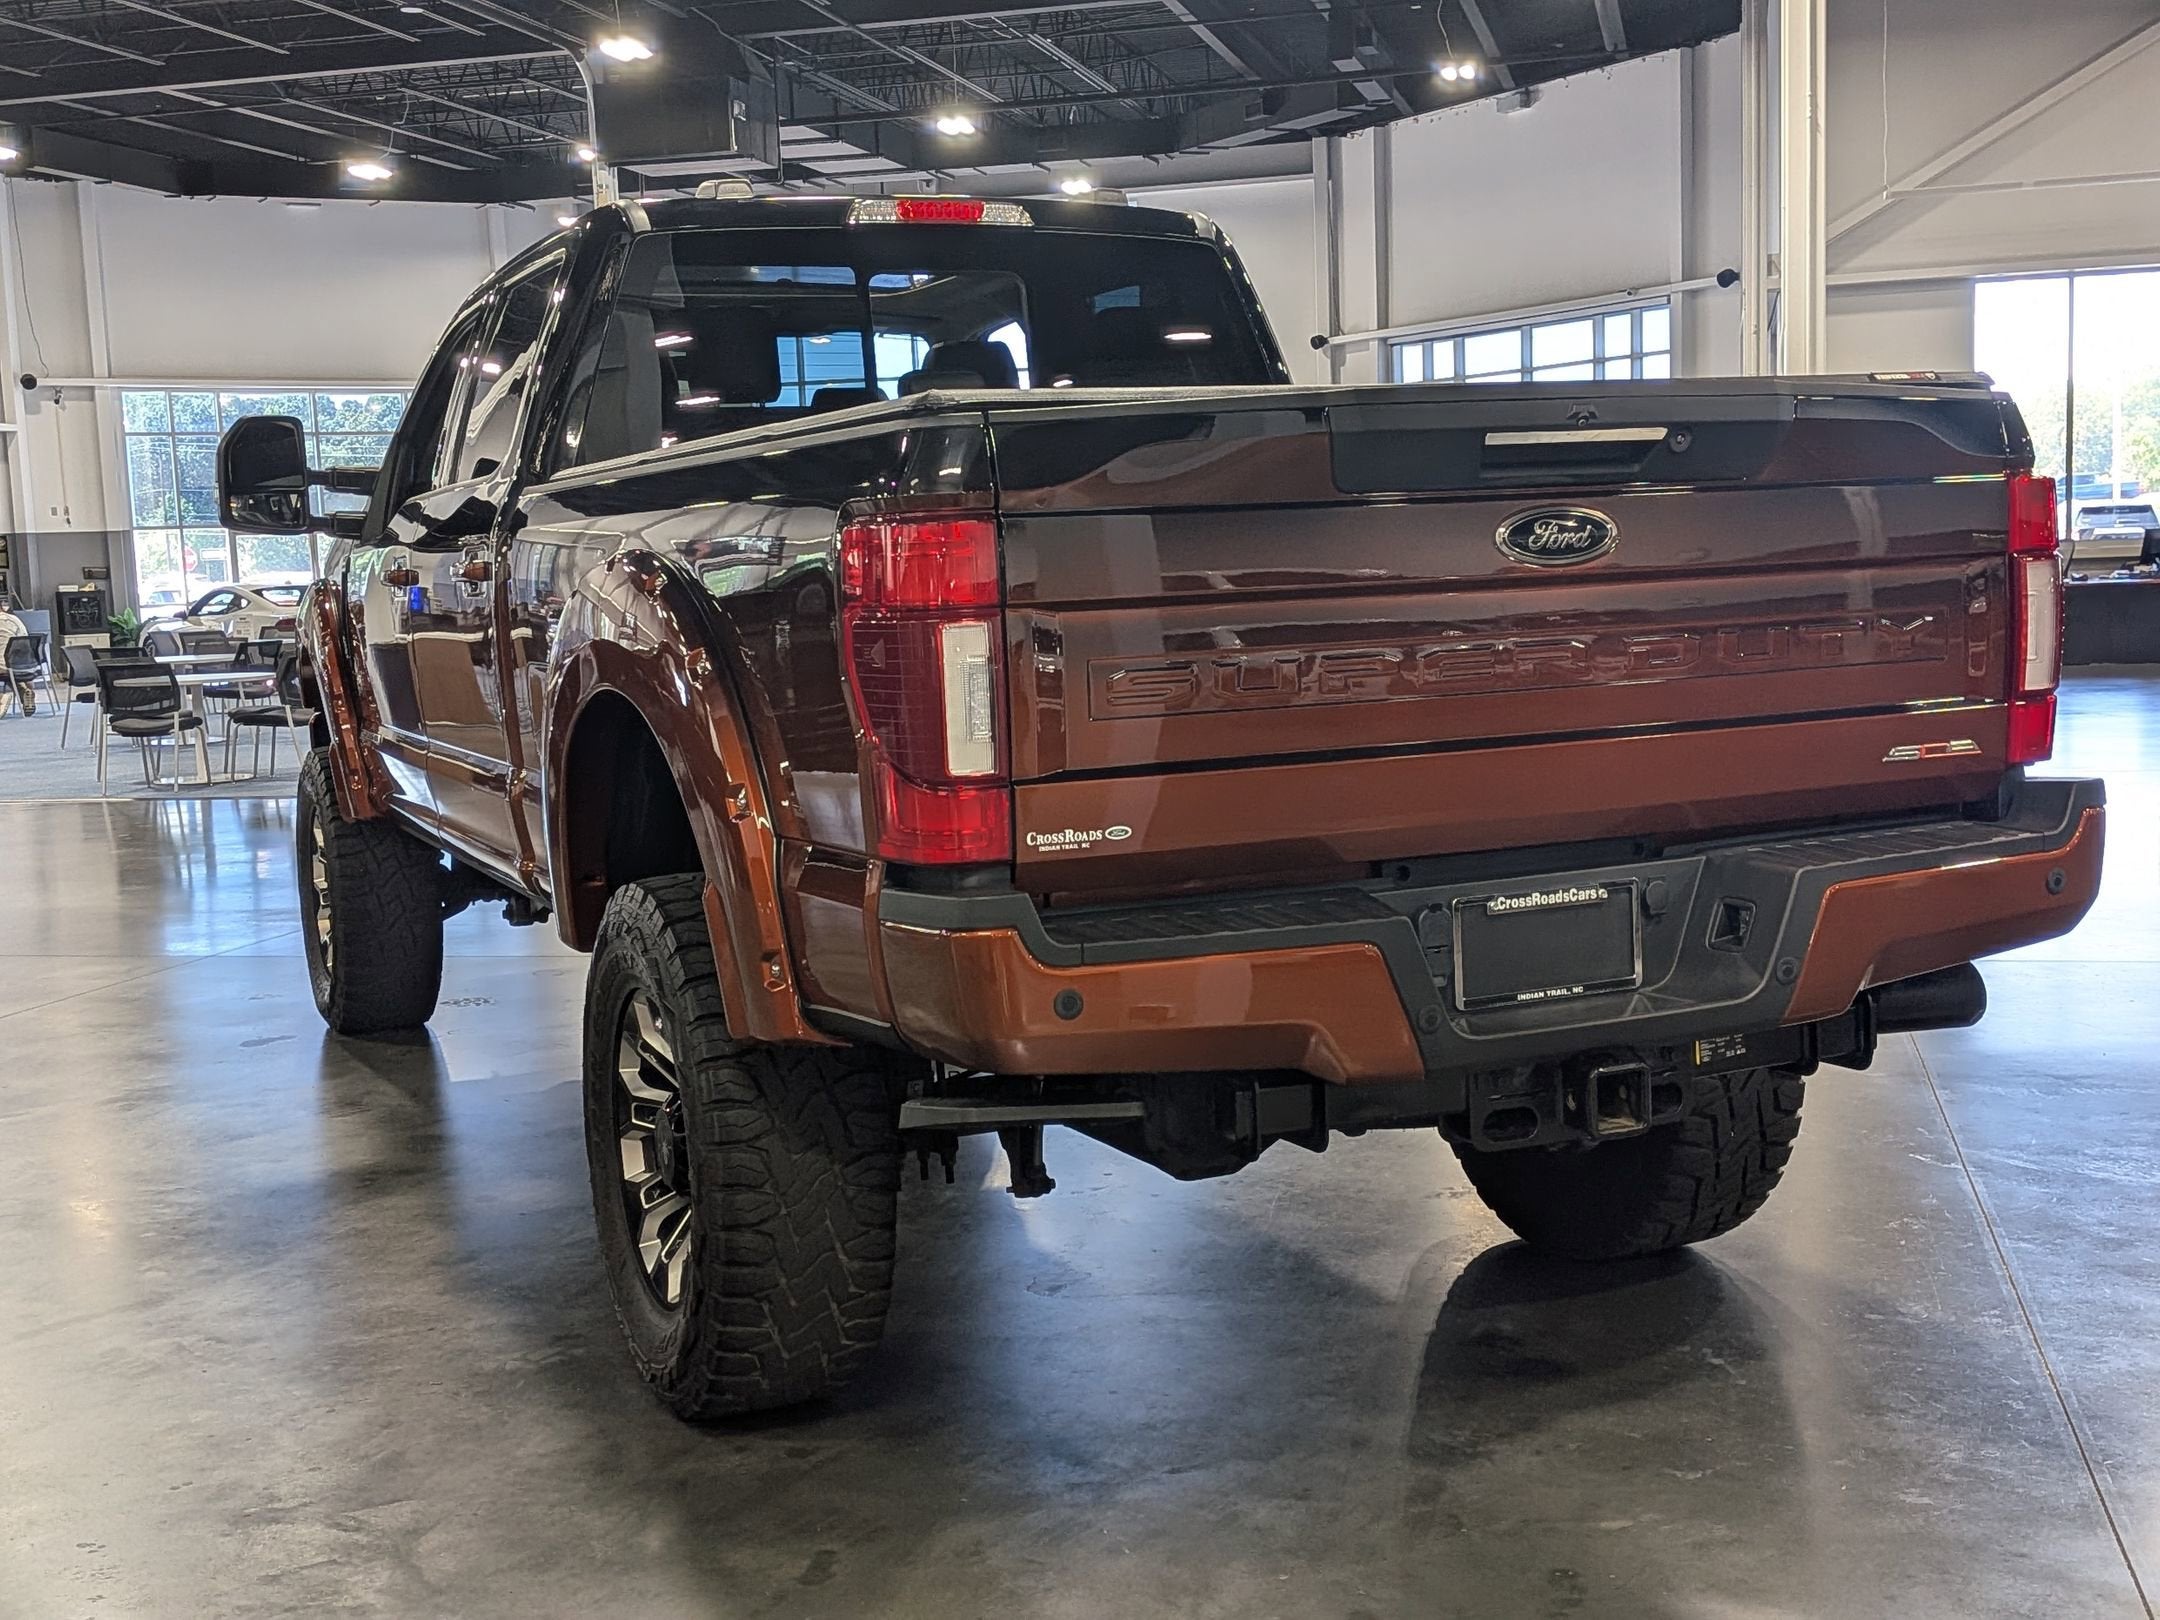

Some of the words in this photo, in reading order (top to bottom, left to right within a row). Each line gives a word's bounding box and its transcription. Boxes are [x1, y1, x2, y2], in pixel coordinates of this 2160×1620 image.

[1528, 518, 1592, 550] Ford
[1106, 637, 1590, 707] SUPER
[1622, 614, 1936, 674] DUTY
[1517, 991, 1544, 1001] INDIAN
[1572, 986, 1584, 994] NC
